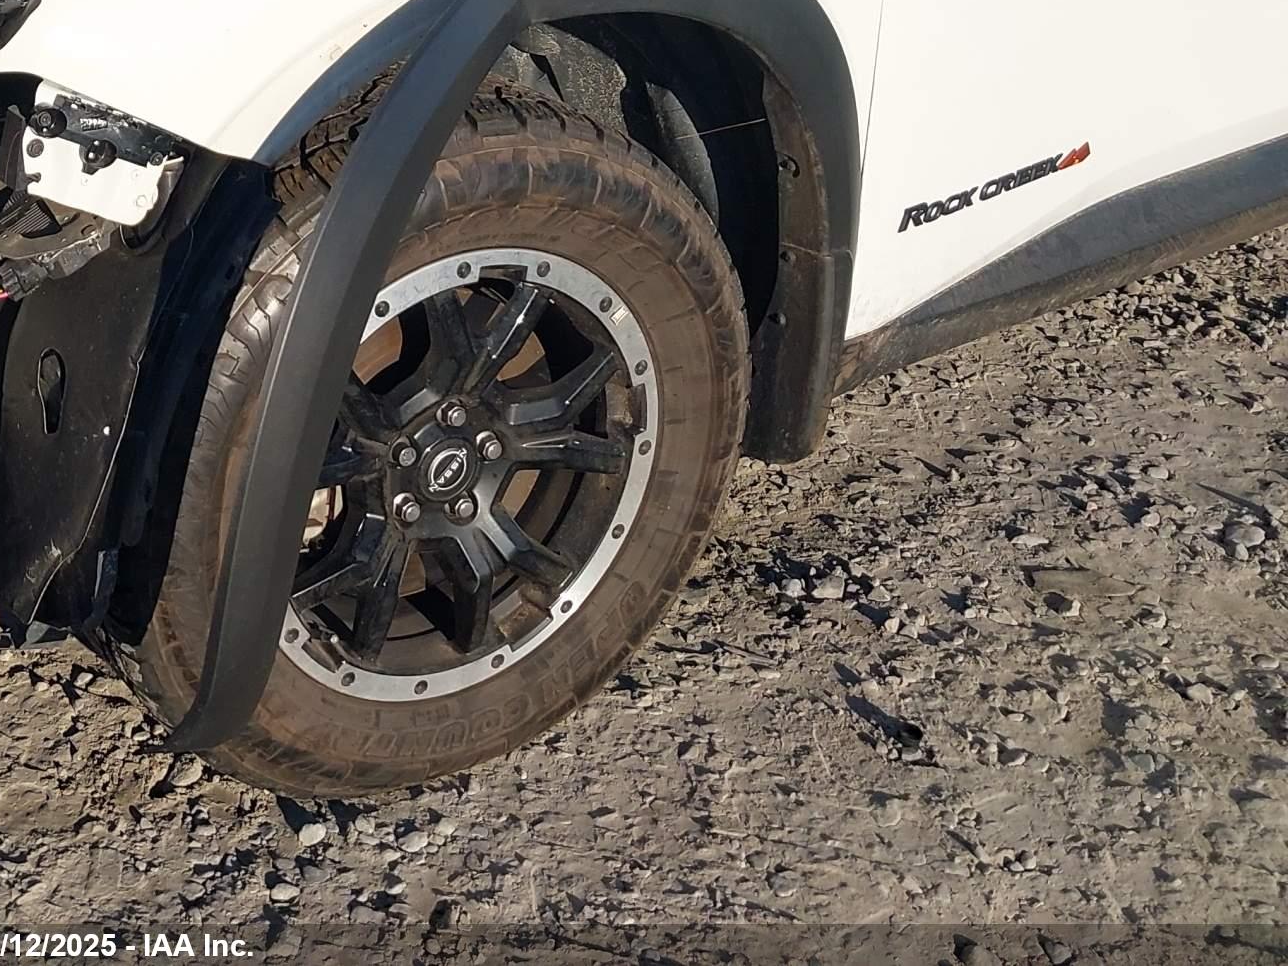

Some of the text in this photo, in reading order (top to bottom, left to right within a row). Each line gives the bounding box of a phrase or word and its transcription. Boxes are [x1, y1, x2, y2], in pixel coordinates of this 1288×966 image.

[897, 153, 1063, 233] ROCK CREEK
[428, 447, 467, 493] NISSAN
